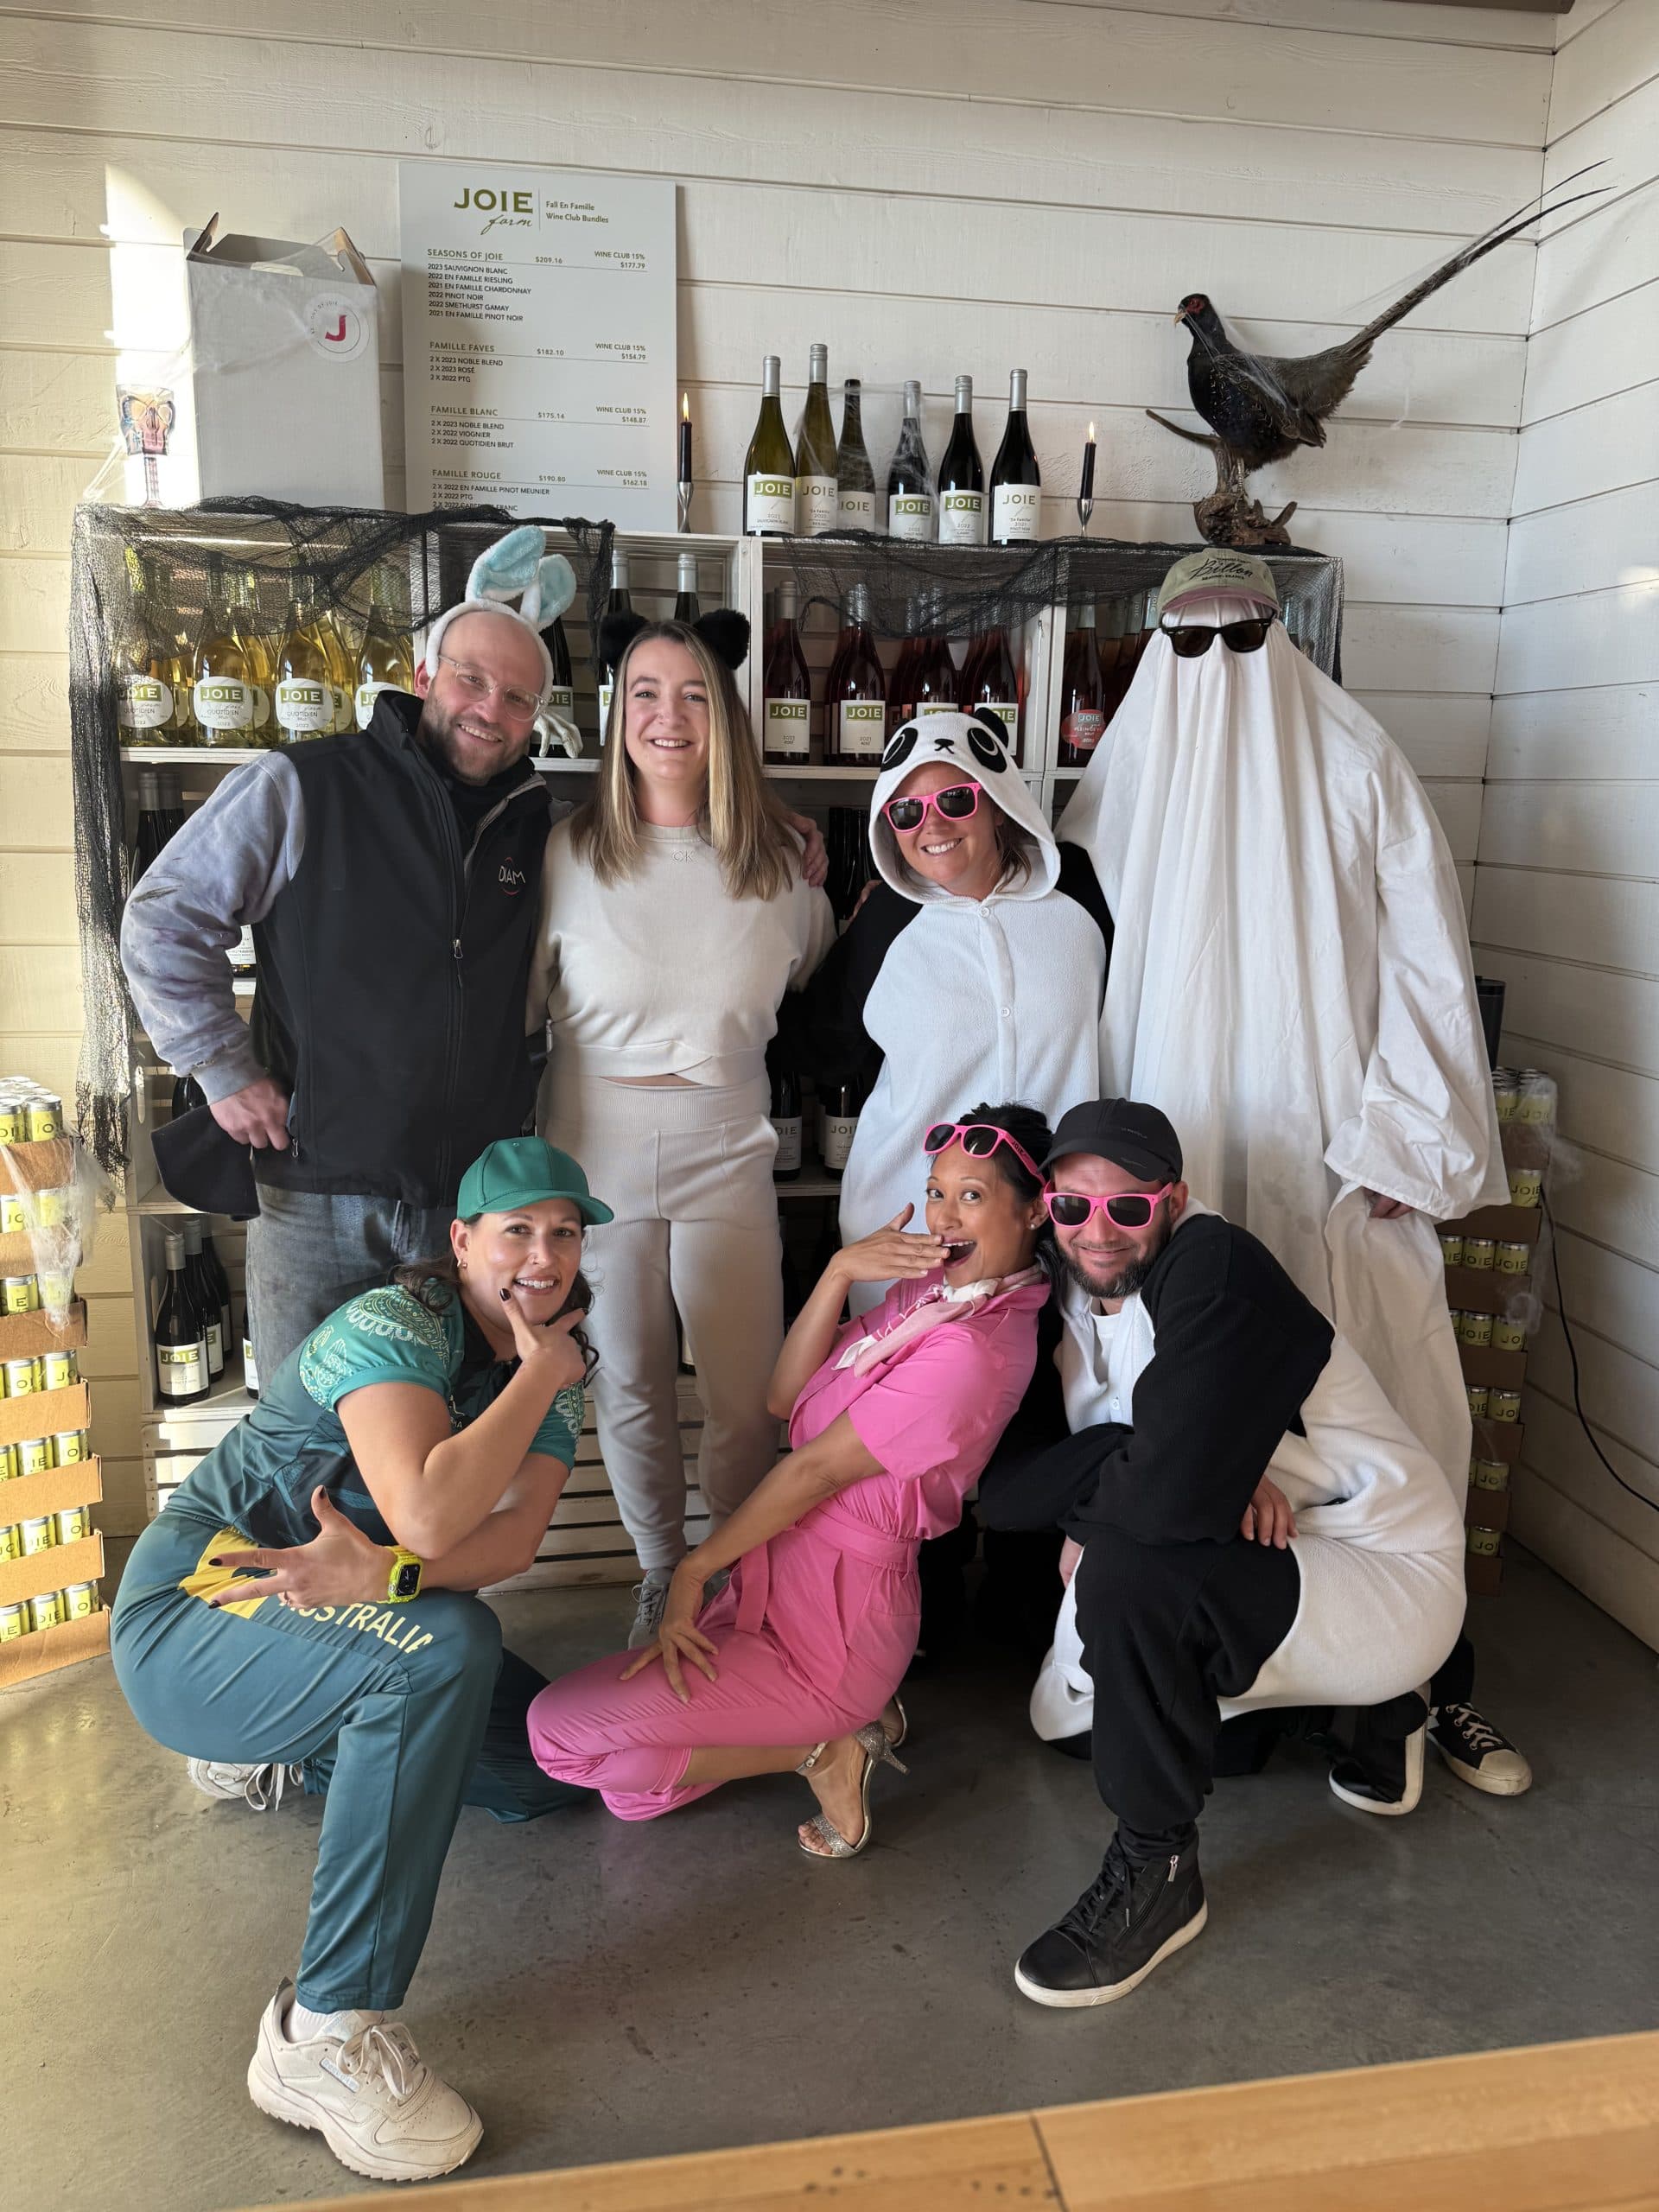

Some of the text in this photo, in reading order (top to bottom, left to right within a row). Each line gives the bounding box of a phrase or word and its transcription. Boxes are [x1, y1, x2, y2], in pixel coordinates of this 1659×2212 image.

[454, 188, 533, 213] JOIE
[570, 202, 594, 211] Famille
[480, 214, 532, 235] farm
[427, 248, 467, 258] SEASONS
[485, 252, 504, 261] JOIE
[535, 256, 563, 264] $209.16
[444, 264, 484, 273] SAUVIGNON
[455, 274, 483, 283] FAMILLE
[484, 276, 513, 284] RIESLING
[455, 283, 483, 292] FAMILLE
[484, 285, 531, 295] CHARDONNAY
[444, 302, 483, 310] SMETHURST
[456, 311, 483, 320] FAMILLE
[325, 315, 346, 341] J
[429, 341, 495, 353] FAMILLE FAVES
[537, 347, 564, 356] $182.10
[431, 405, 498, 416] FAMILLE BLANC
[432, 469, 501, 480] FAMILLE ROUGE
[756, 483, 791, 496] JOIE
[802, 486, 835, 497] JOIE
[947, 498, 980, 510] JOIE
[1002, 494, 1036, 505] JOIE
[838, 501, 869, 512] JOIE
[897, 502, 930, 513] JOIE
[119, 688, 158, 698] JOIE
[202, 688, 243, 700] JOIE
[283, 689, 321, 702] JOIE
[548, 694, 569, 704] OIE
[772, 706, 805, 717] JOIE
[849, 708, 881, 718] JOIE
[994, 711, 1014, 721] OIE
[775, 1126, 798, 1135] OIE
[830, 1125, 855, 1135] JOI
[1496, 1258, 1527, 1269] JOIE
[162, 1350, 199, 1363] JOIE
